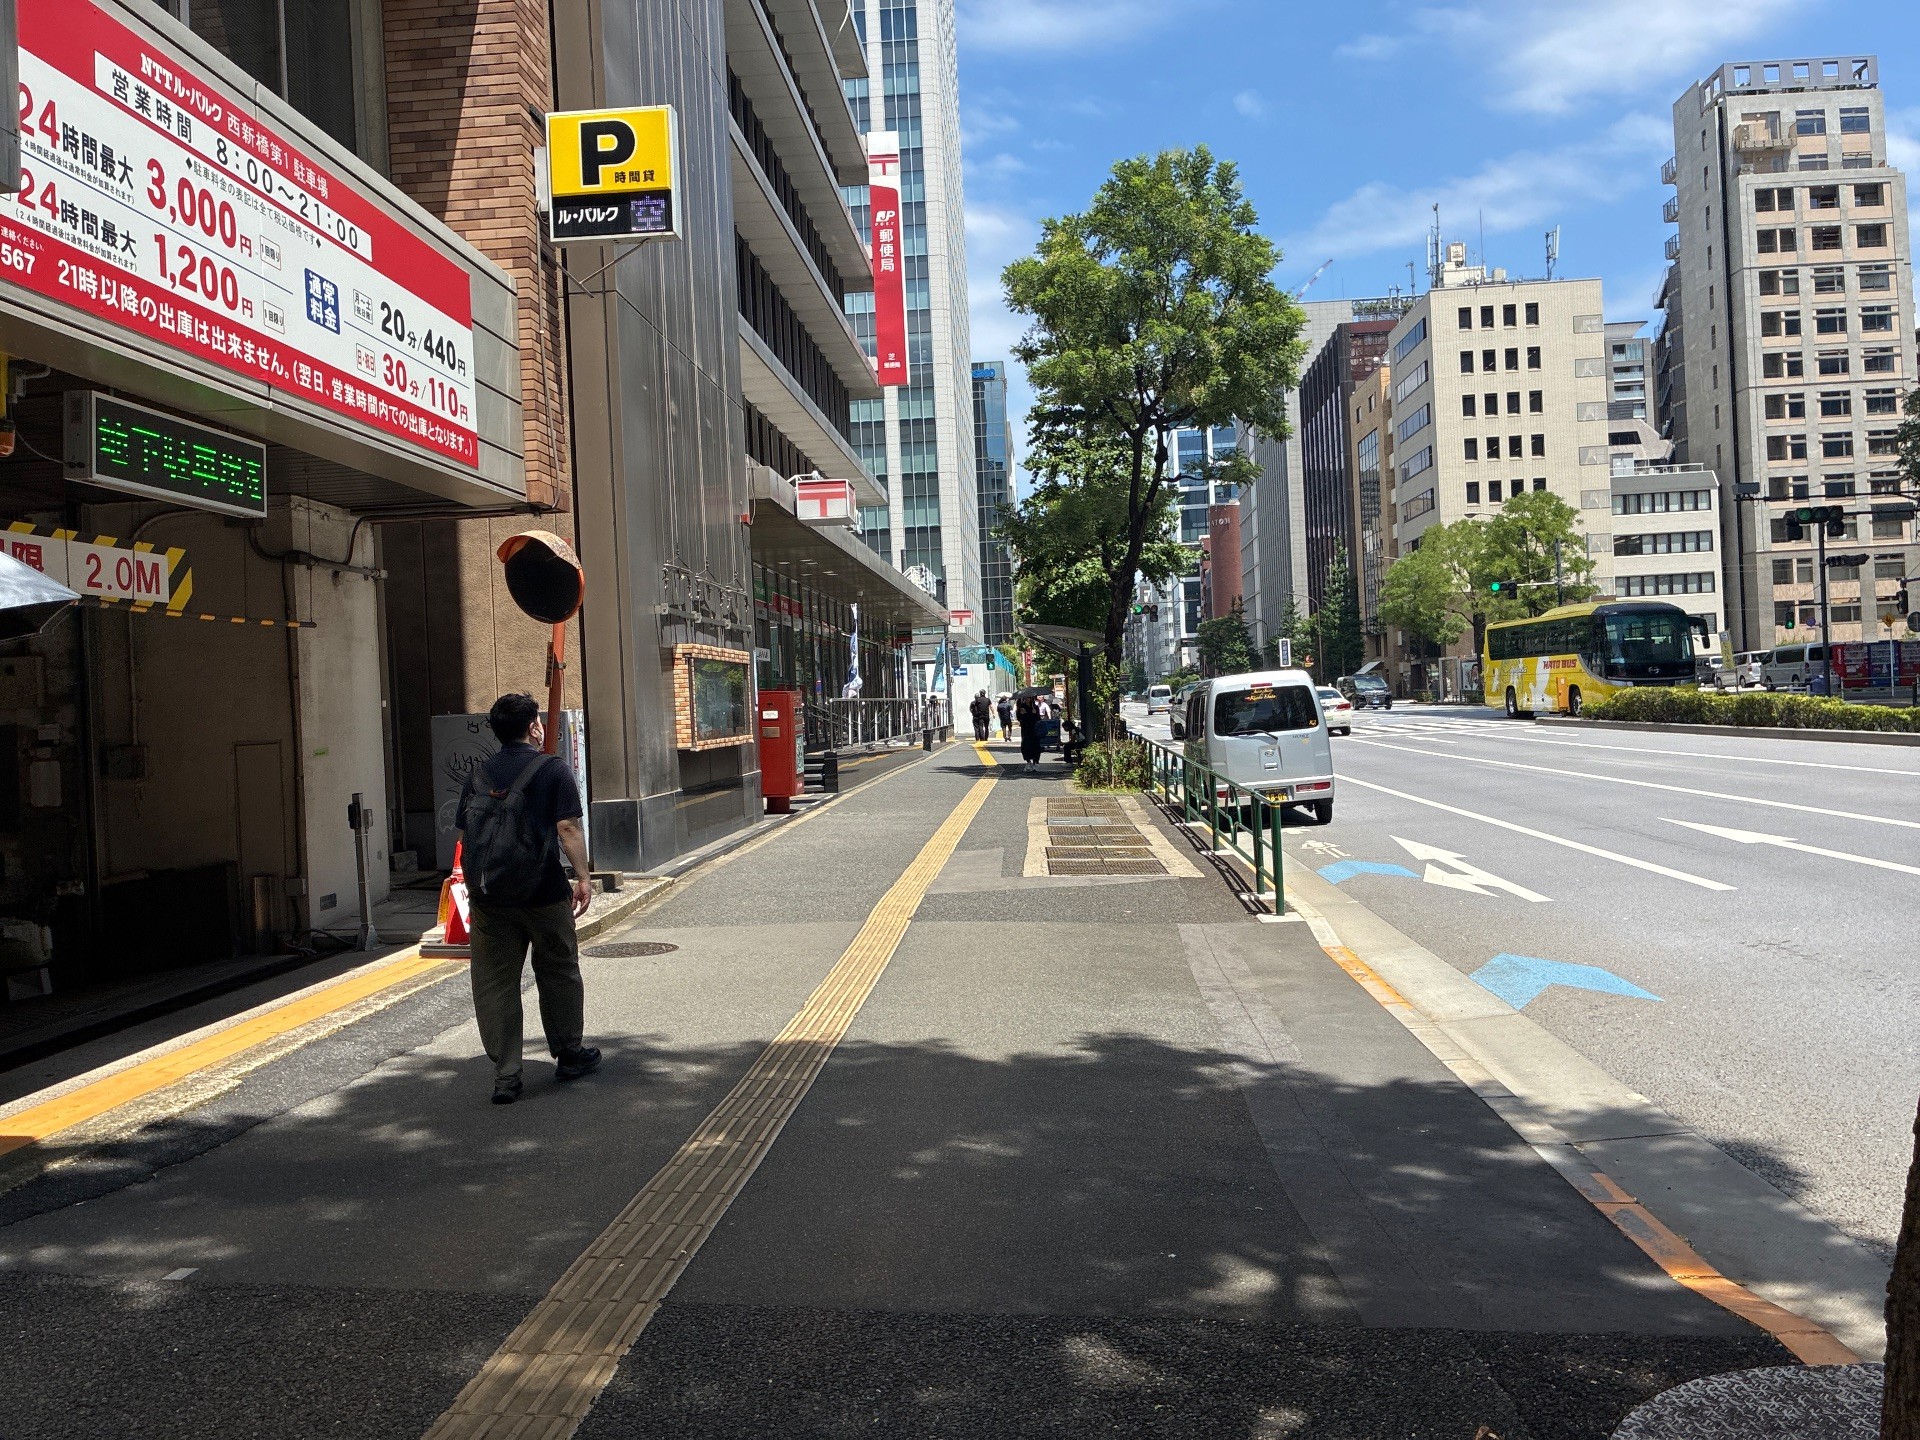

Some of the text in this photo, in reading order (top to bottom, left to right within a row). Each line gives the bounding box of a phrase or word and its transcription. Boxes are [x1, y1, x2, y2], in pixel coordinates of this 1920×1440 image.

[112, 68, 192, 144] 営業時間
[580, 120, 636, 186] P
[614, 169, 655, 183] 時間貸
[146, 157, 253, 258] 3,000円
[558, 206, 619, 225] ル・パルク
[0, 242, 36, 275] 567
[17, 167, 137, 259] 24時間最大
[153, 233, 253, 319] 1,200円
[879, 228, 895, 273] 郵便局
[309, 271, 335, 306] 通常
[310, 297, 338, 331] 料金
[380, 301, 466, 377] 20分/440円
[382, 352, 468, 422] 30分/110円
[85, 553, 161, 595] 2.0M
[1561, 659, 1577, 669] BUS
